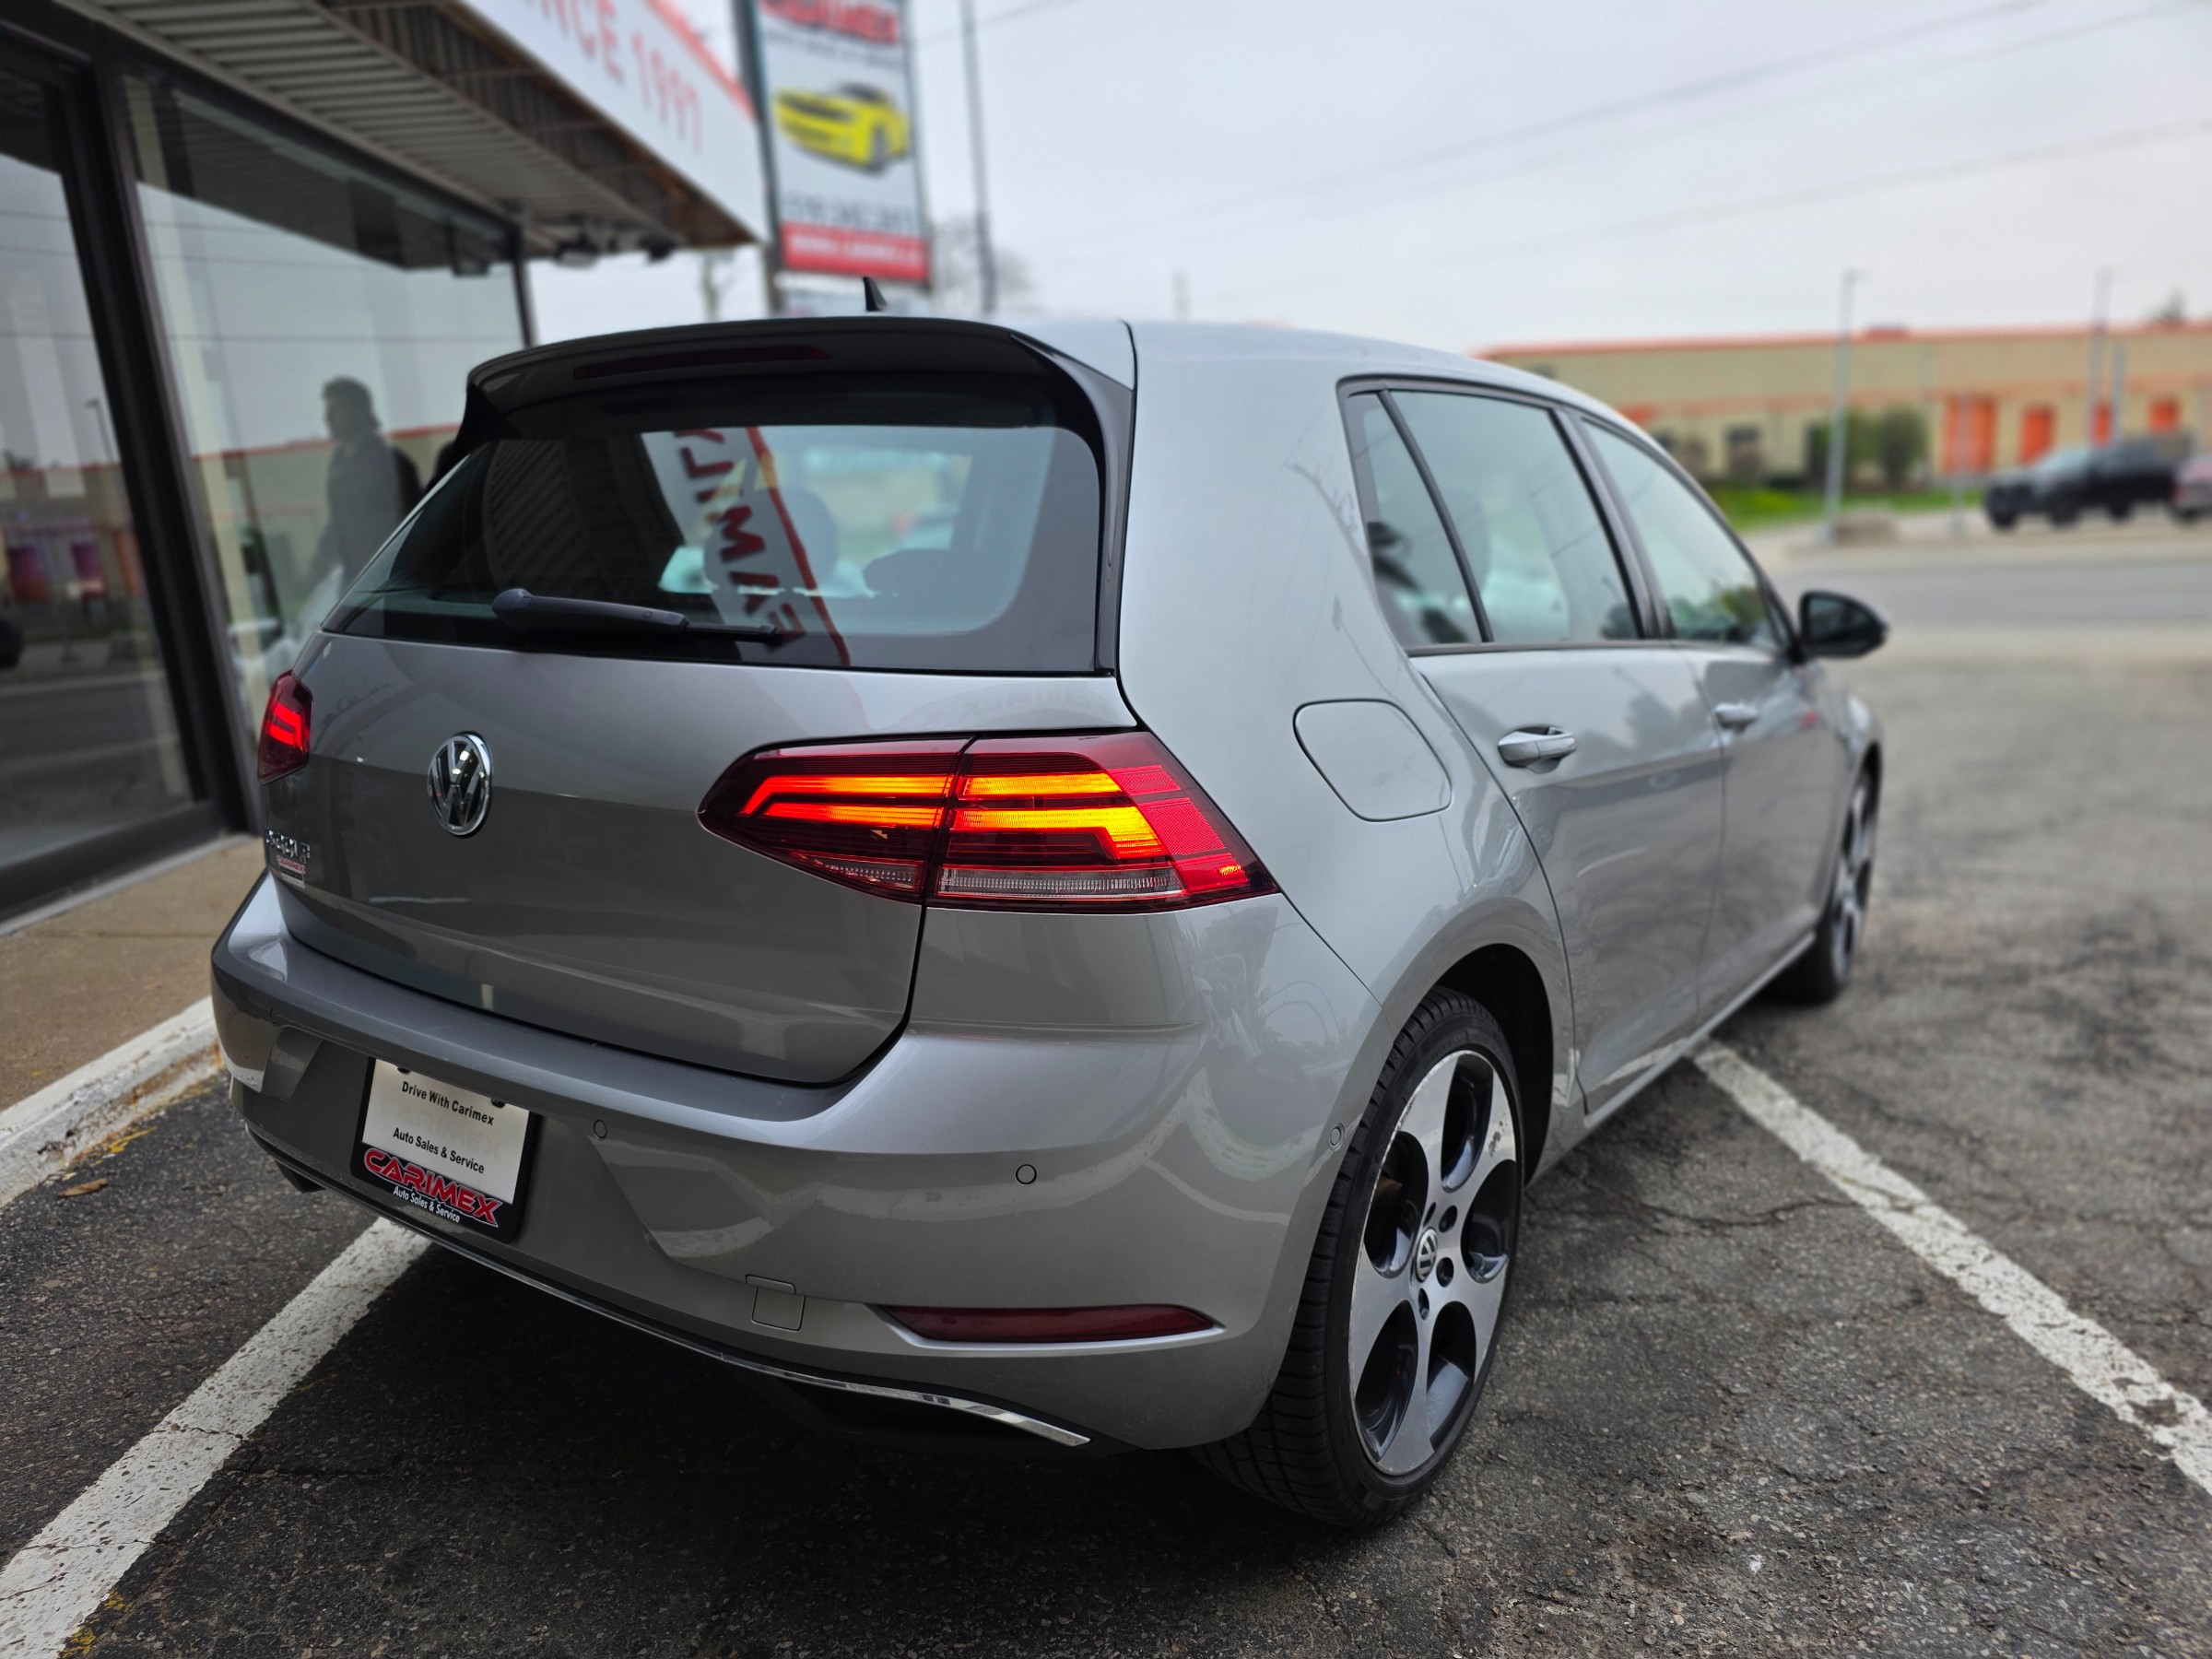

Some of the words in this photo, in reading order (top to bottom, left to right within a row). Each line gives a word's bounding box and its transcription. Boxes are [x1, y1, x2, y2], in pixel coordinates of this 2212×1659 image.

[402, 1081, 427, 1100] Drive
[429, 1090, 451, 1110] With
[452, 1100, 495, 1125] Carimex
[393, 1127, 415, 1145] Auto
[416, 1136, 440, 1155] Sales
[441, 1147, 448, 1159] &
[450, 1151, 485, 1174] Service
[364, 1147, 503, 1227] CARIMEX
[393, 1186, 409, 1201] Auto
[410, 1194, 428, 1209] Sales
[429, 1202, 435, 1212] &
[436, 1205, 461, 1224] Service
